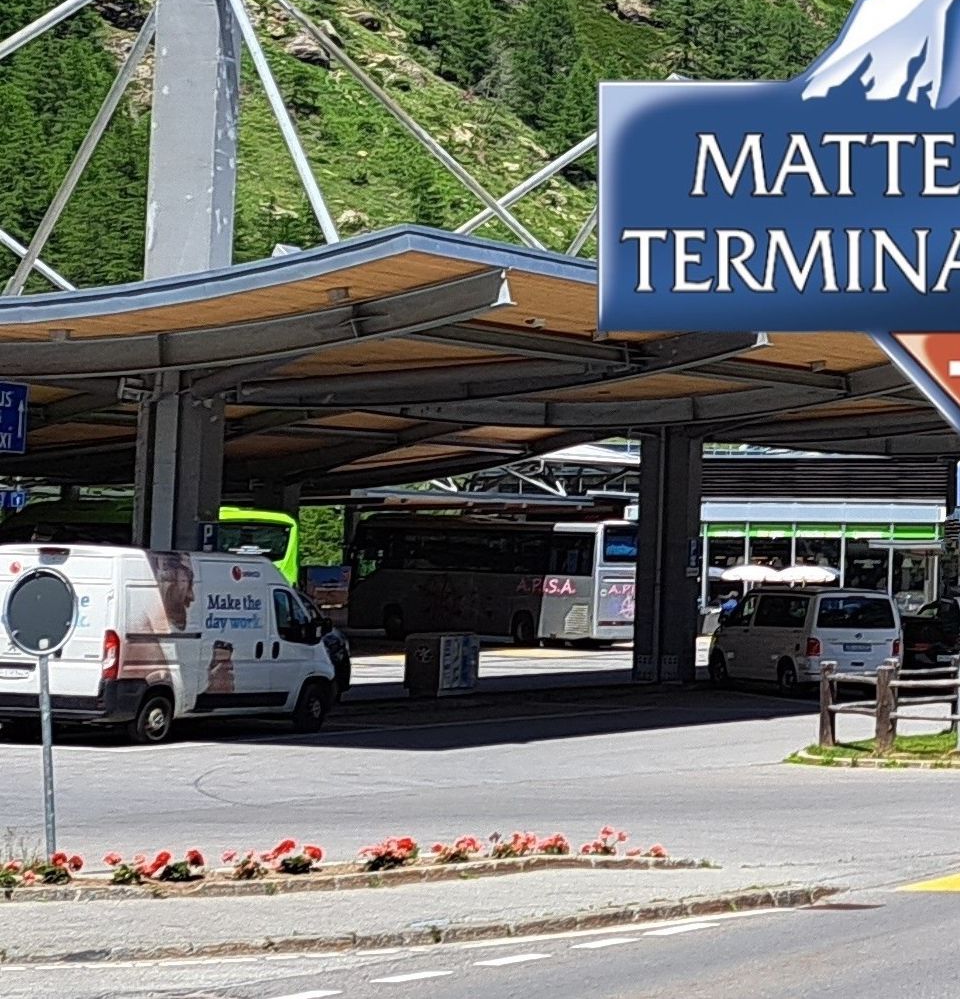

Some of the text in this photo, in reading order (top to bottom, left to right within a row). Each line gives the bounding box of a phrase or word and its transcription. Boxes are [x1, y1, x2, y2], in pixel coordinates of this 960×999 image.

[207, 594, 262, 610] Make the
[205, 613, 228, 633] day
